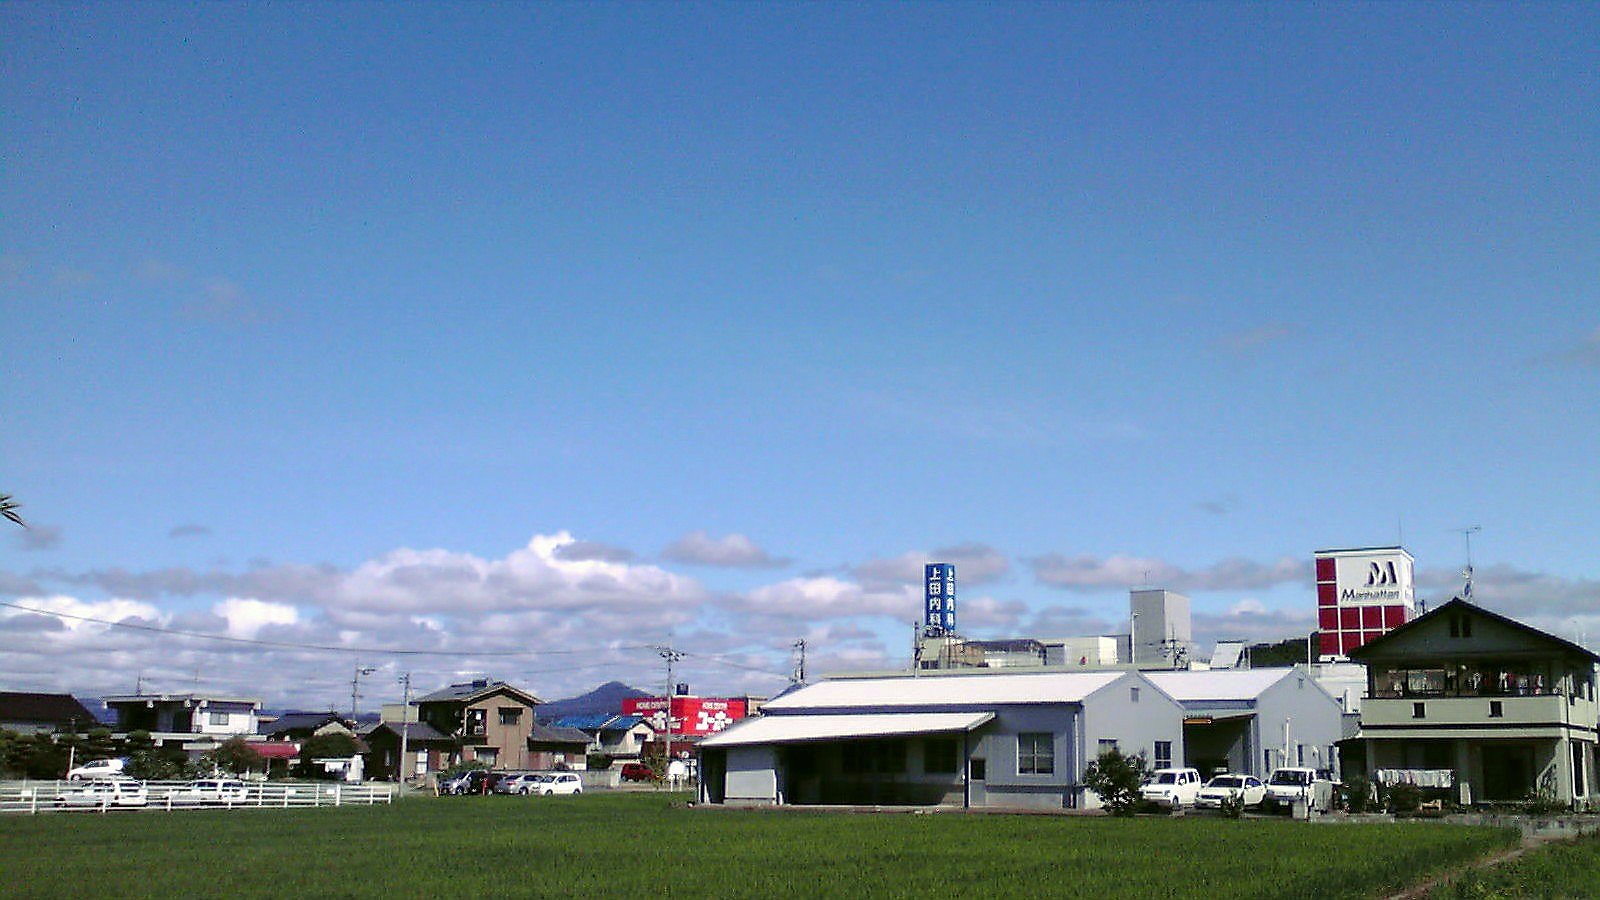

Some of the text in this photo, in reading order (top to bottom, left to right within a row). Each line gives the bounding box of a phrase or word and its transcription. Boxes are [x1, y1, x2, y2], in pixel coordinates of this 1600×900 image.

[929, 567, 942, 626] 上田内科
[1341, 588, 1400, 601] Manhattan
